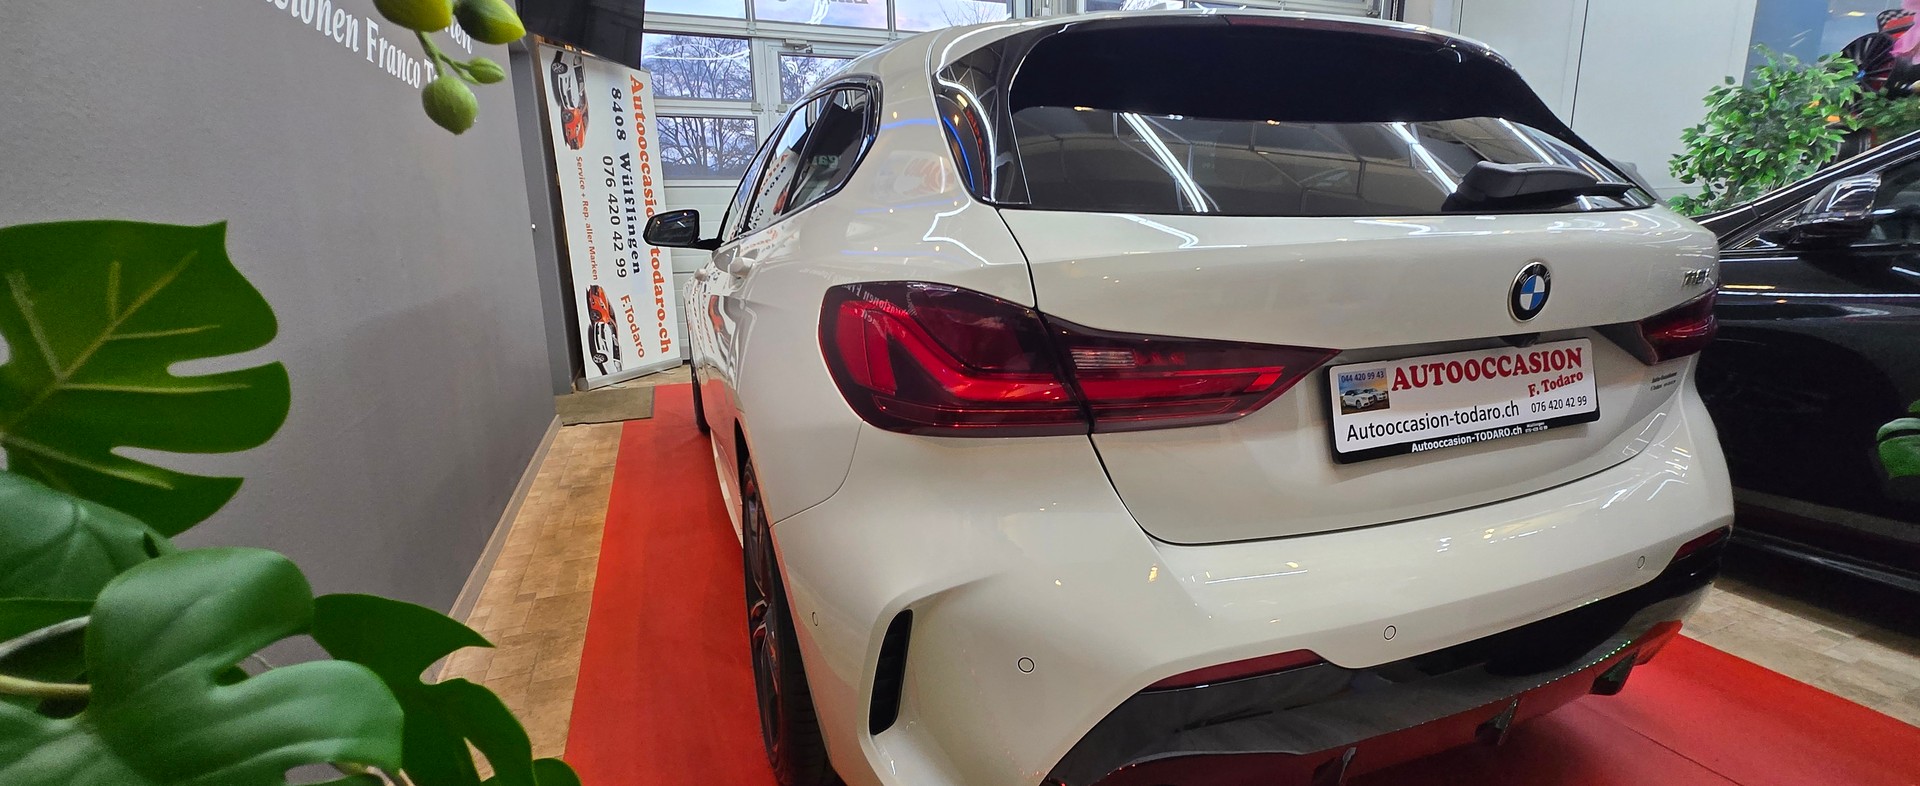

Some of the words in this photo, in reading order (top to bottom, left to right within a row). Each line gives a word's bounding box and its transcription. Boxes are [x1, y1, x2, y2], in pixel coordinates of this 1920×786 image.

[366, 17, 421, 88] Franco
[576, 156, 586, 190] Service
[602, 156, 616, 188] 076
[611, 87, 627, 141] 8408
[619, 152, 640, 274] Wülflingen
[607, 193, 621, 226] 420
[585, 222, 593, 243] aller
[612, 231, 624, 251] 42
[588, 246, 598, 280] Marken
[615, 258, 627, 278] 99
[1341, 374, 1353, 383] 044
[1354, 372, 1365, 381] 420
[1367, 371, 1375, 379] 99
[1376, 370, 1384, 378] 43
[1391, 347, 1582, 391] AUTOOCCASION
[1528, 383, 1539, 397] F.
[1541, 372, 1583, 393] Todaro
[1531, 401, 1546, 413] 076
[1548, 398, 1563, 410] 420
[1565, 397, 1575, 408] 42
[1577, 395, 1587, 406] 99
[1347, 400, 1519, 441] Autooccasion-todaro.ch
[1411, 425, 1522, 453] Autooccasion-TODARO.ch
